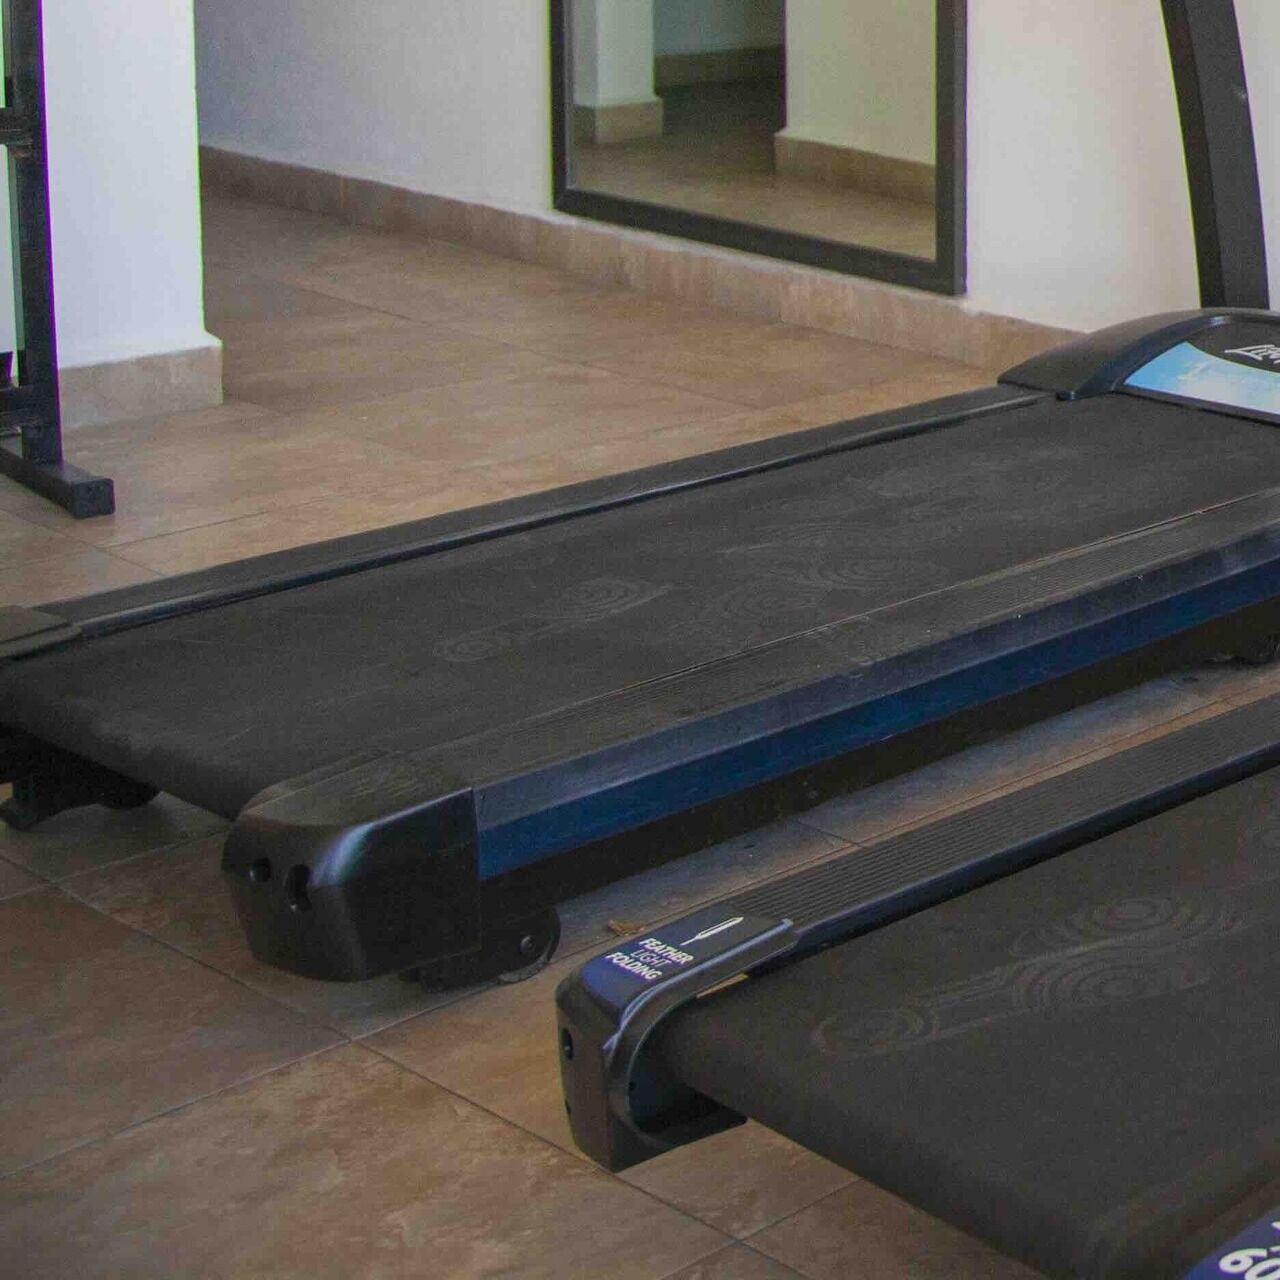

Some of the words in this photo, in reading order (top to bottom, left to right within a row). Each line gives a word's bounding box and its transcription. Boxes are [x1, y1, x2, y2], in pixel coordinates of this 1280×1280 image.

[630, 949, 672, 967] LIGHT
[639, 938, 694, 965] FEATHER
[604, 951, 663, 980] FOLDING
